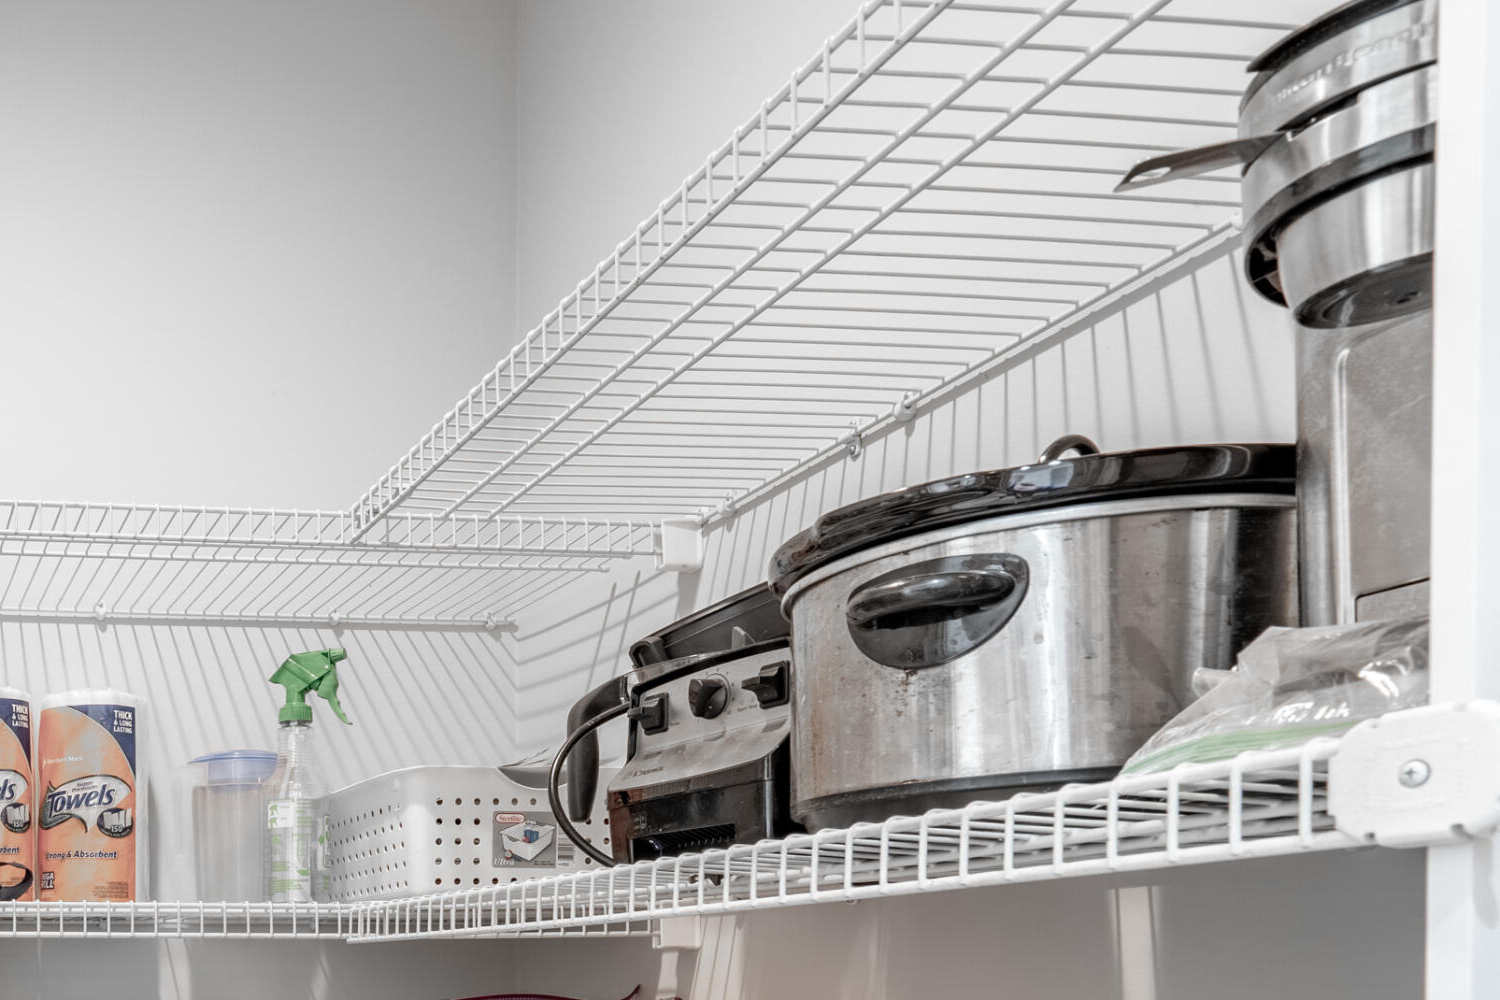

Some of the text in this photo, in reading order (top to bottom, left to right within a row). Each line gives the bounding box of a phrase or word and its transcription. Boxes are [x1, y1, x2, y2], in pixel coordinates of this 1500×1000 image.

[12, 704, 28, 715] THICK
[114, 710, 132, 720] THICK
[119, 720, 132, 728] LONG
[114, 726, 132, 734] LASTING
[48, 784, 116, 818] Towels
[74, 850, 116, 859] Absorbent
